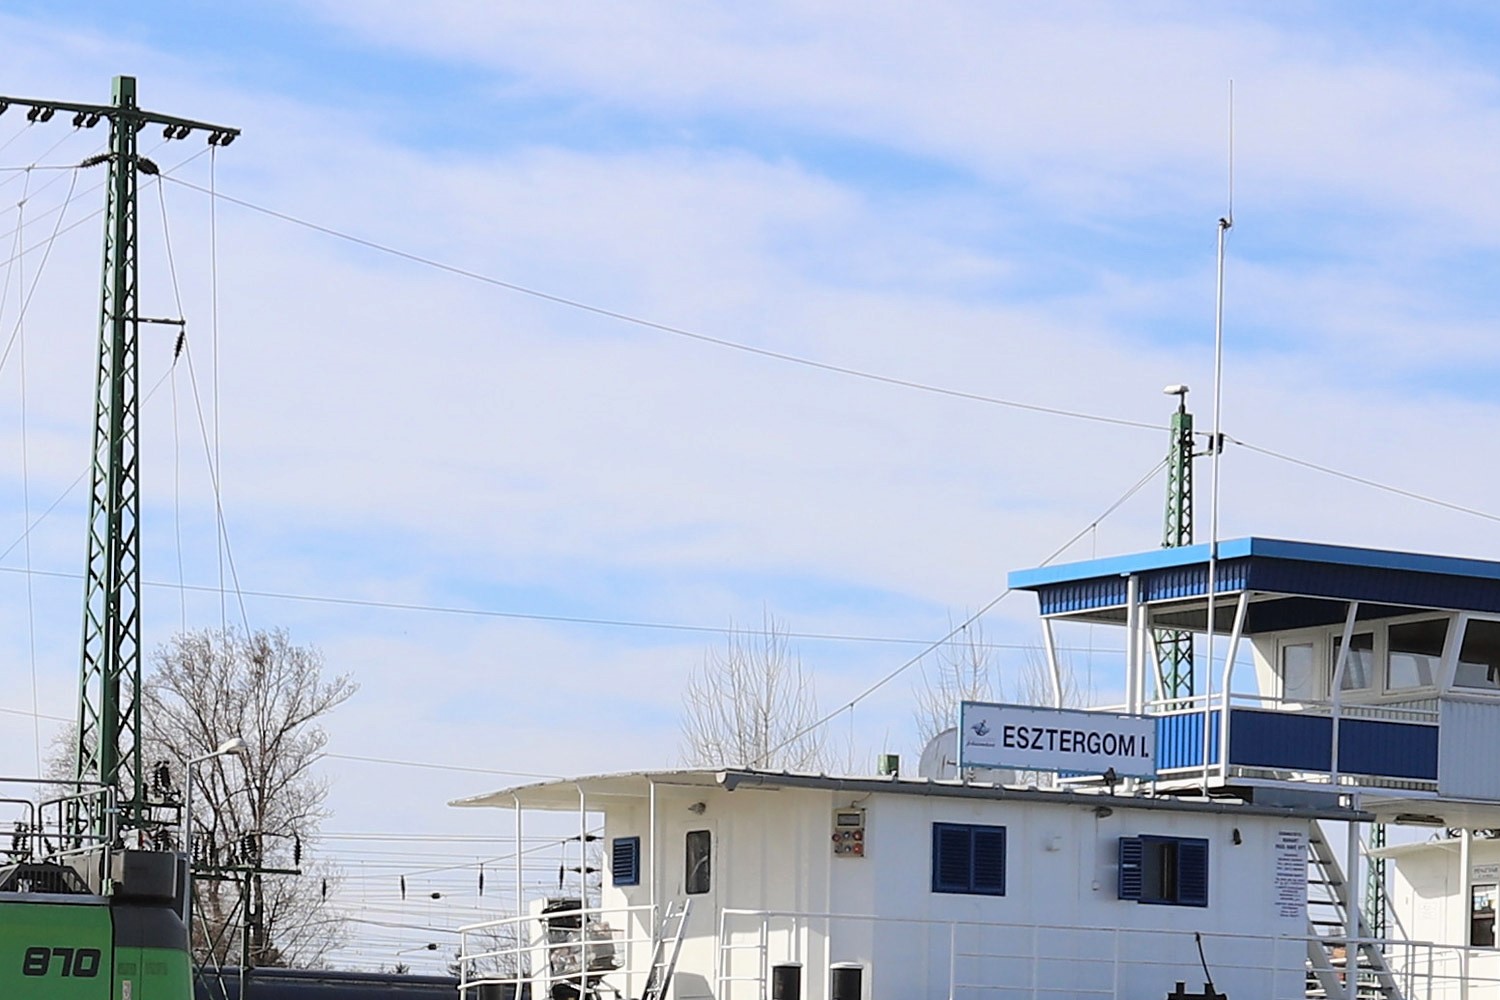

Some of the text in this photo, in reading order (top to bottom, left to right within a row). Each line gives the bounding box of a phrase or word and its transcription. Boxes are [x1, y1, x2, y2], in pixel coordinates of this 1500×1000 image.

[1003, 725, 1149, 758] ESZTERGOM I.
[23, 947, 101, 977] 870
